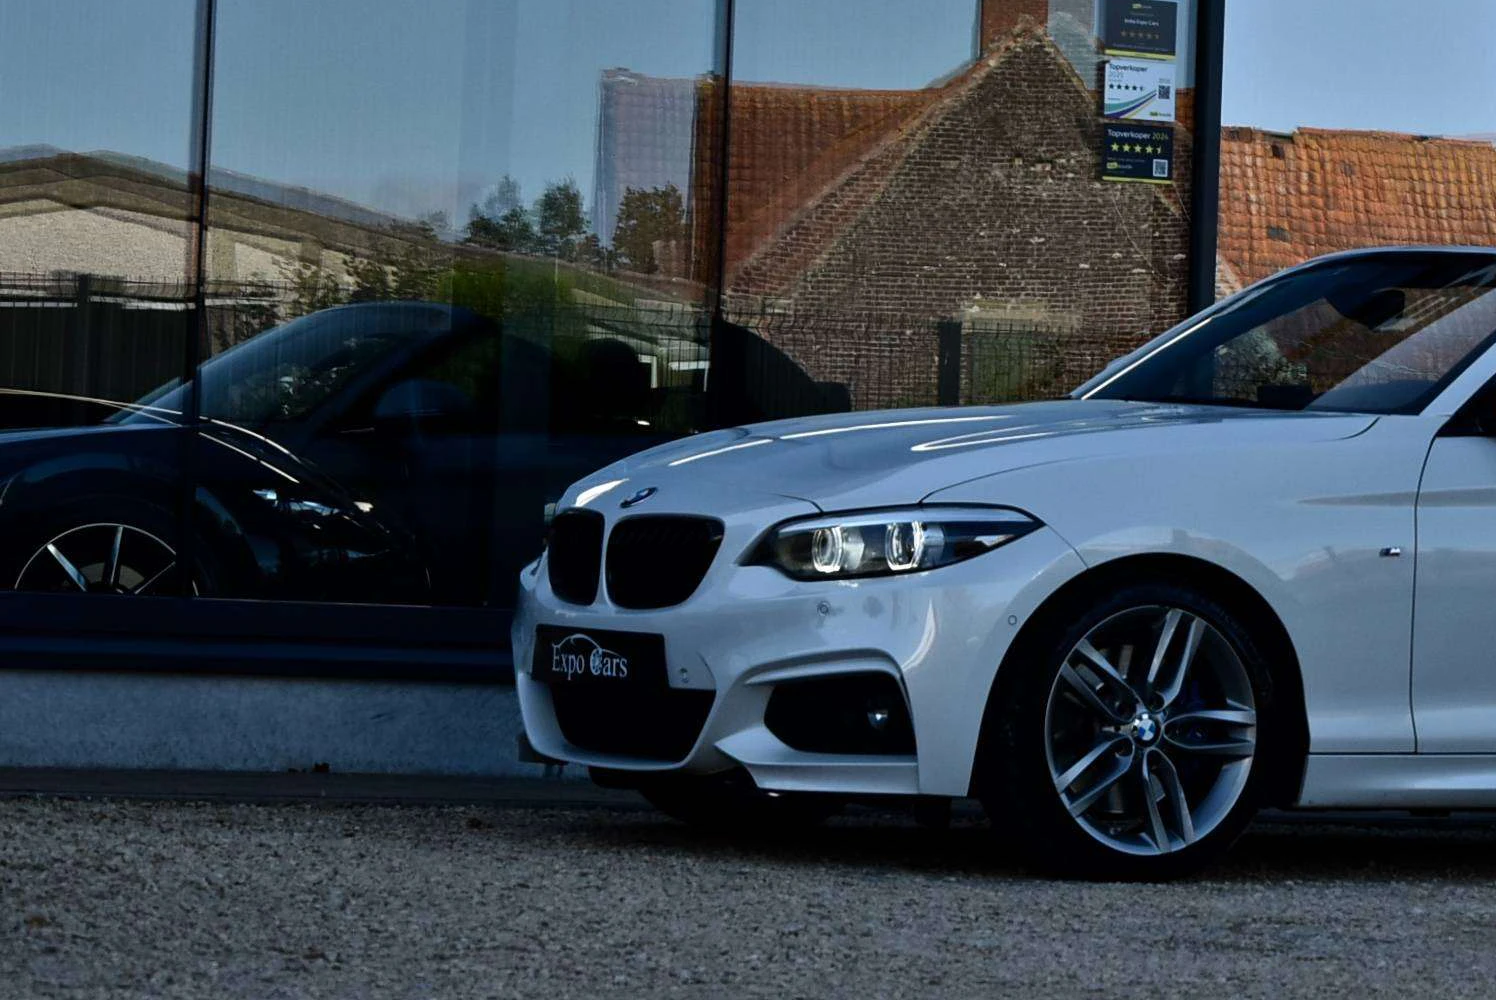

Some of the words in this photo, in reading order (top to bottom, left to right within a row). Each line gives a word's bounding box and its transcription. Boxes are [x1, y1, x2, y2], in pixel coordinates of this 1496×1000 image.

[1109, 63, 1149, 73] Topverkoper
[1107, 128, 1151, 140] Topverkoper
[551, 643, 585, 680] Expo
[589, 647, 628, 678] Cars
